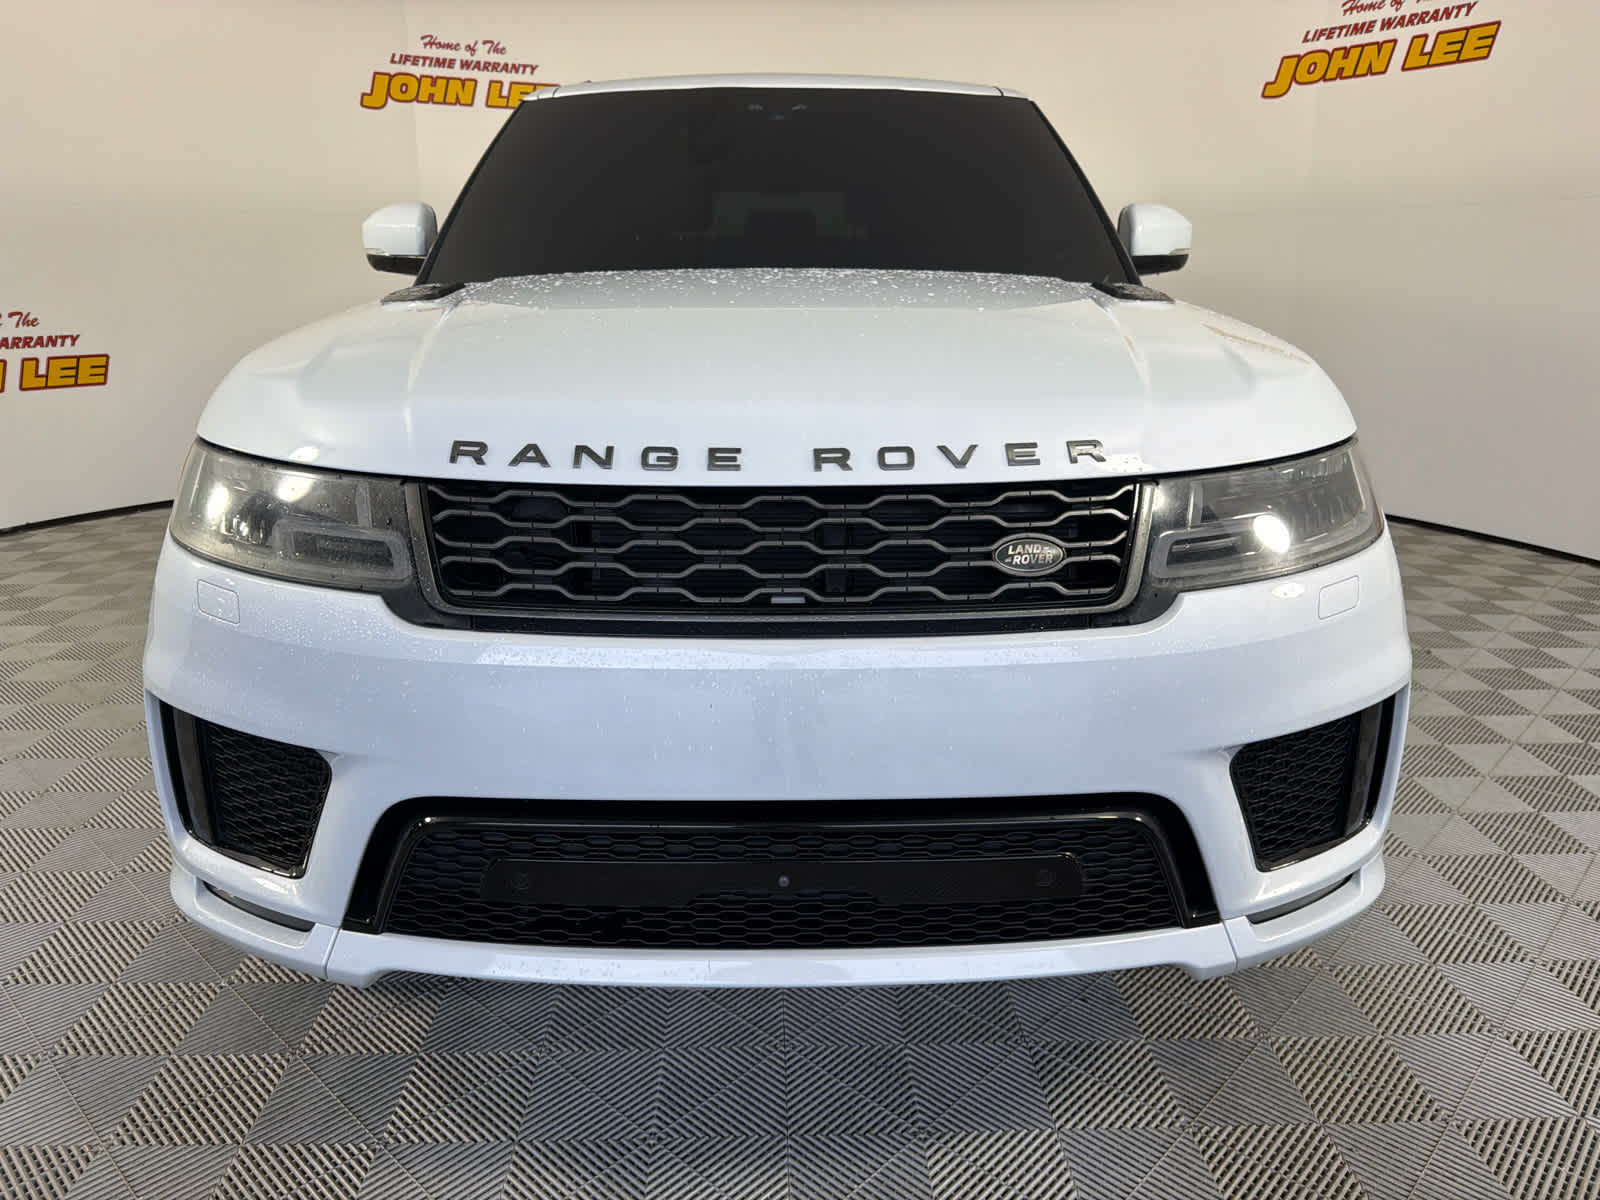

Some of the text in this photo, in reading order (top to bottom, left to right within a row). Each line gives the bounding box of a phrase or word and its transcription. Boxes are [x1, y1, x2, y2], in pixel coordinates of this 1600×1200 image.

[1302, 1, 1479, 43] LIFETIME WARRANTY
[420, 34, 508, 57] Home of The
[1261, 20, 1502, 98] JOHN LEE
[389, 53, 540, 76] LIFETIME WARRANTY
[360, 71, 561, 110] JOHN LE
[7, 311, 40, 328] The
[19, 353, 110, 392] LEE
[449, 438, 1107, 473] RANGE ROVER
